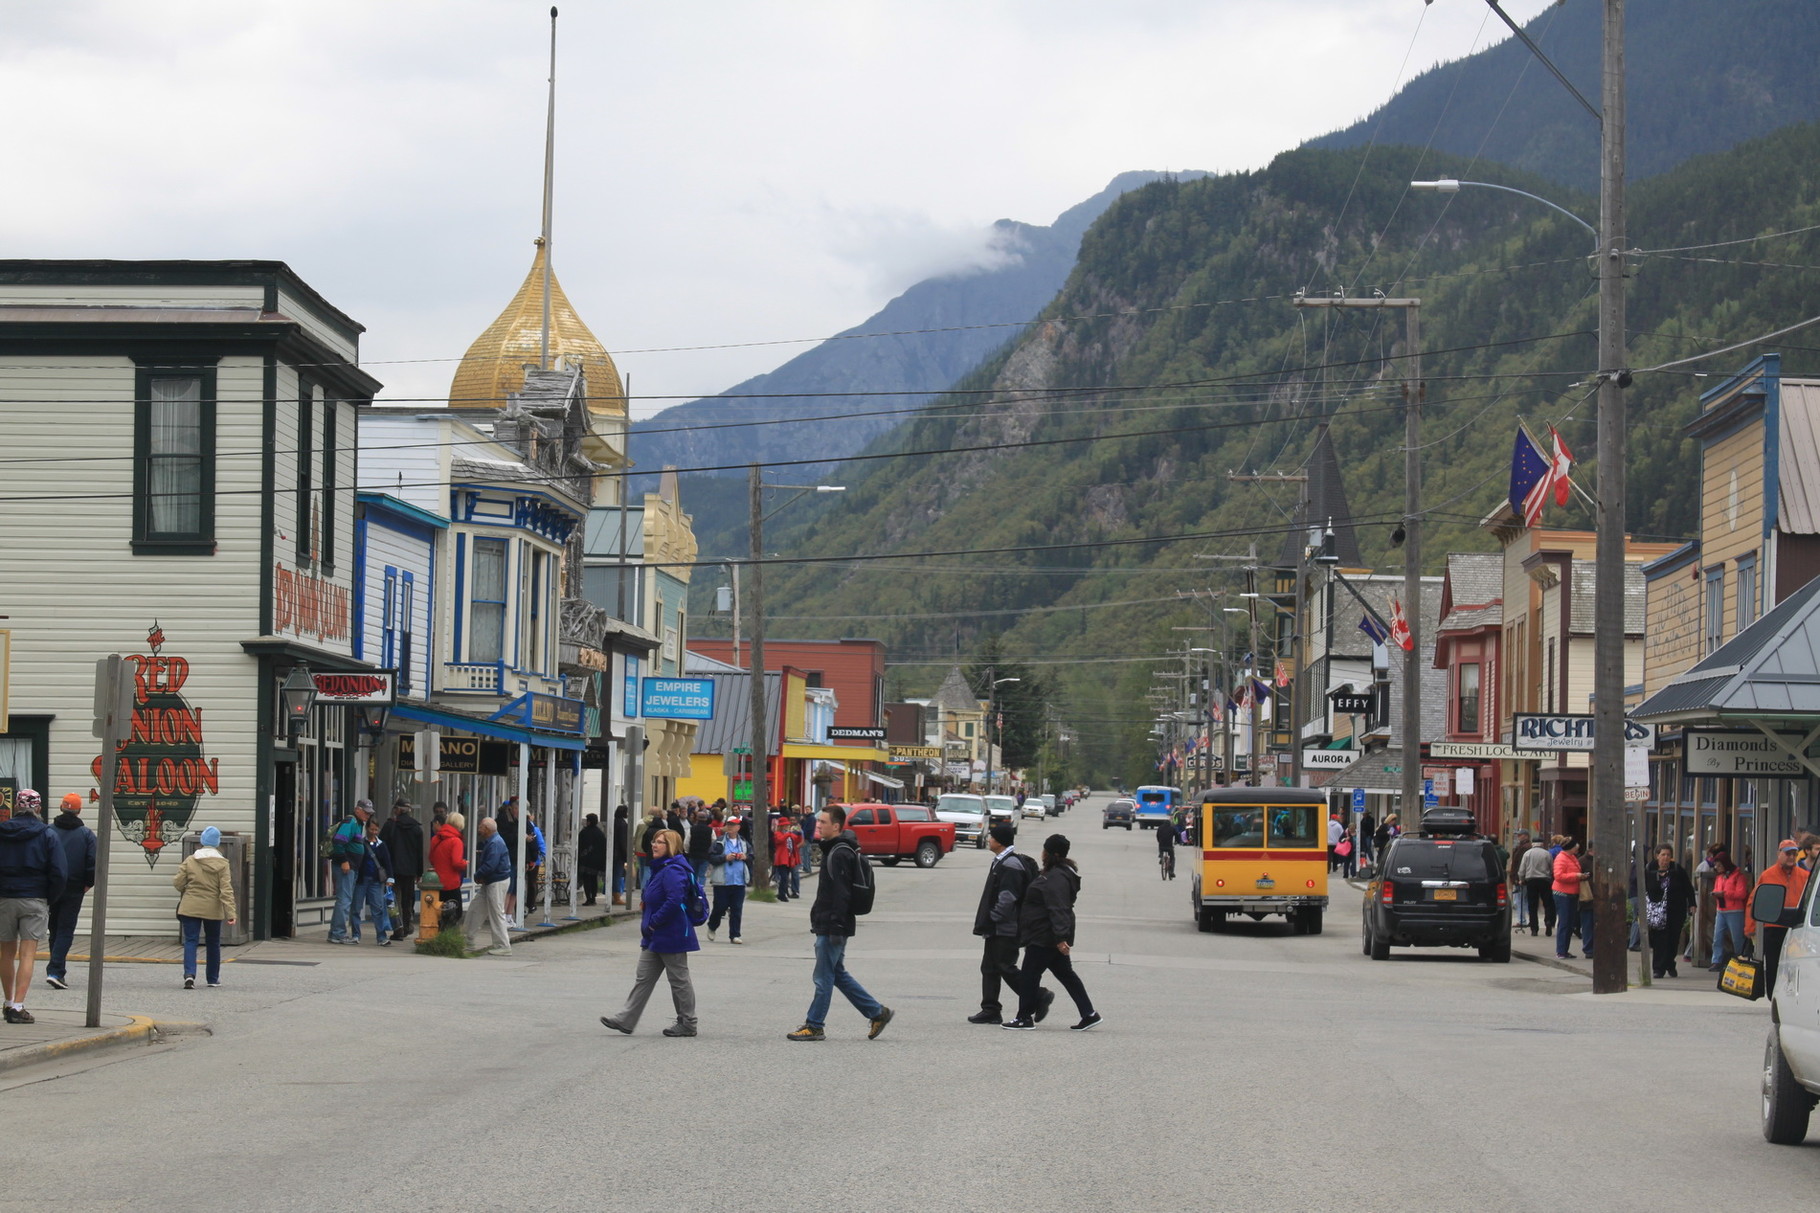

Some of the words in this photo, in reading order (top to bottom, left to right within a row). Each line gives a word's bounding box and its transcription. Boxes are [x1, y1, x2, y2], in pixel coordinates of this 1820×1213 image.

[276, 561, 294, 636] RED
[124, 654, 190, 704] RED
[314, 674, 339, 694] RED
[340, 674, 383, 694] ONION
[655, 681, 702, 693] EMPIRE
[645, 695, 710, 708] JEWELERS
[1337, 698, 1369, 709] EFFY
[115, 706, 203, 751] NION
[831, 728, 884, 738] DEDMAN'S
[1520, 717, 1650, 741] RICHTRS
[401, 740, 477, 756] MANO
[1547, 737, 1583, 747] Jewelry
[1695, 736, 1778, 752] Diamonds
[896, 747, 940, 757] PANTHEON
[1442, 744, 1482, 755] FRESH
[1311, 754, 1352, 764] AURORA
[1734, 756, 1801, 772] Princess
[1625, 790, 1649, 799] BEGIN
